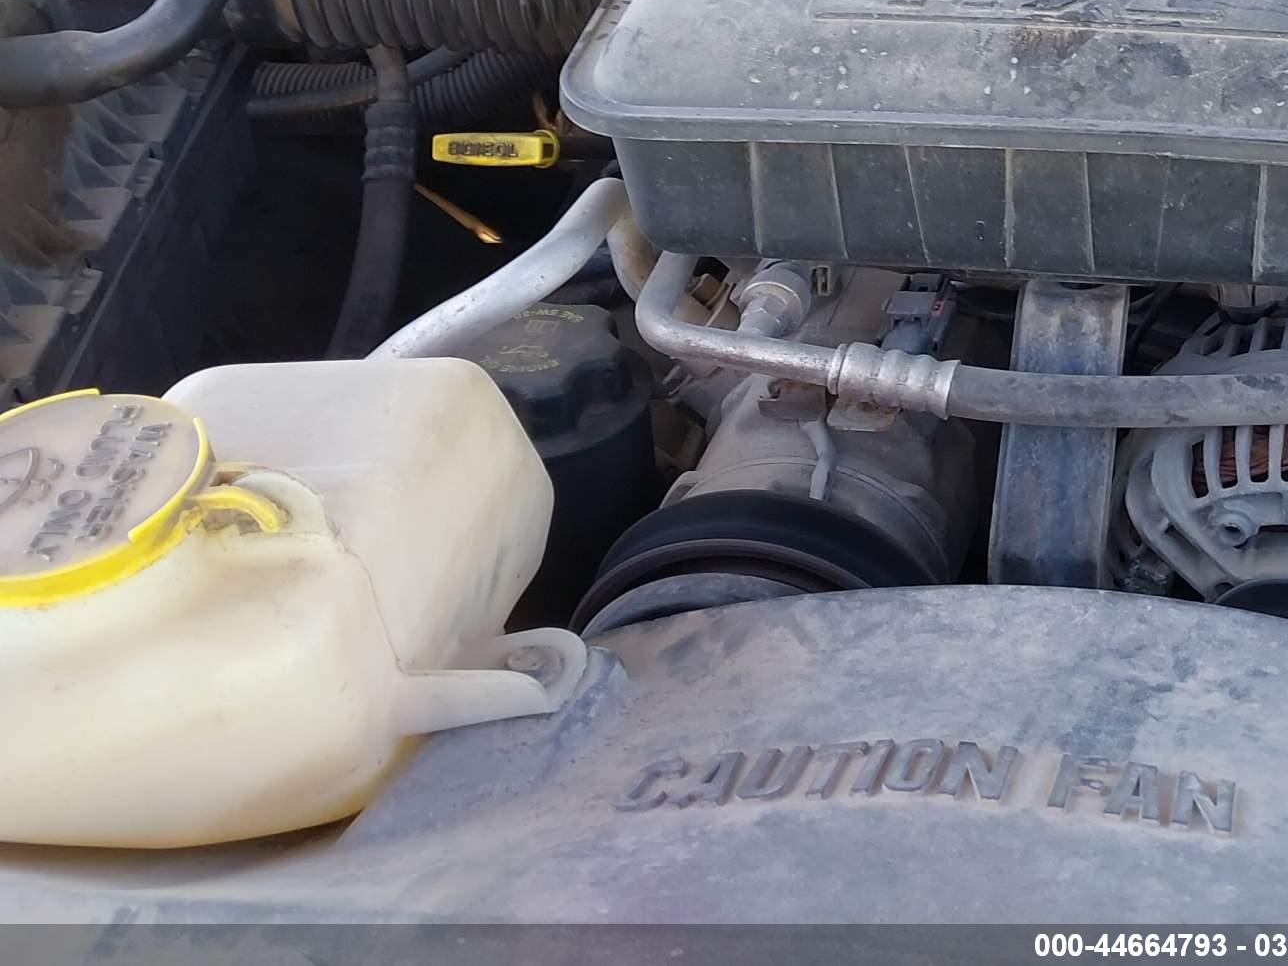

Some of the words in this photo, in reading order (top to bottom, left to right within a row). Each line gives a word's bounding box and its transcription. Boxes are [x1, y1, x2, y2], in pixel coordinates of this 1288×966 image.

[494, 141, 518, 157] OIL
[76, 403, 144, 478] FLUID
[75, 422, 173, 542] WASHER
[24, 489, 92, 562] ONLY
[613, 738, 1019, 812] CAUTION
[1047, 752, 1237, 833] FAN
